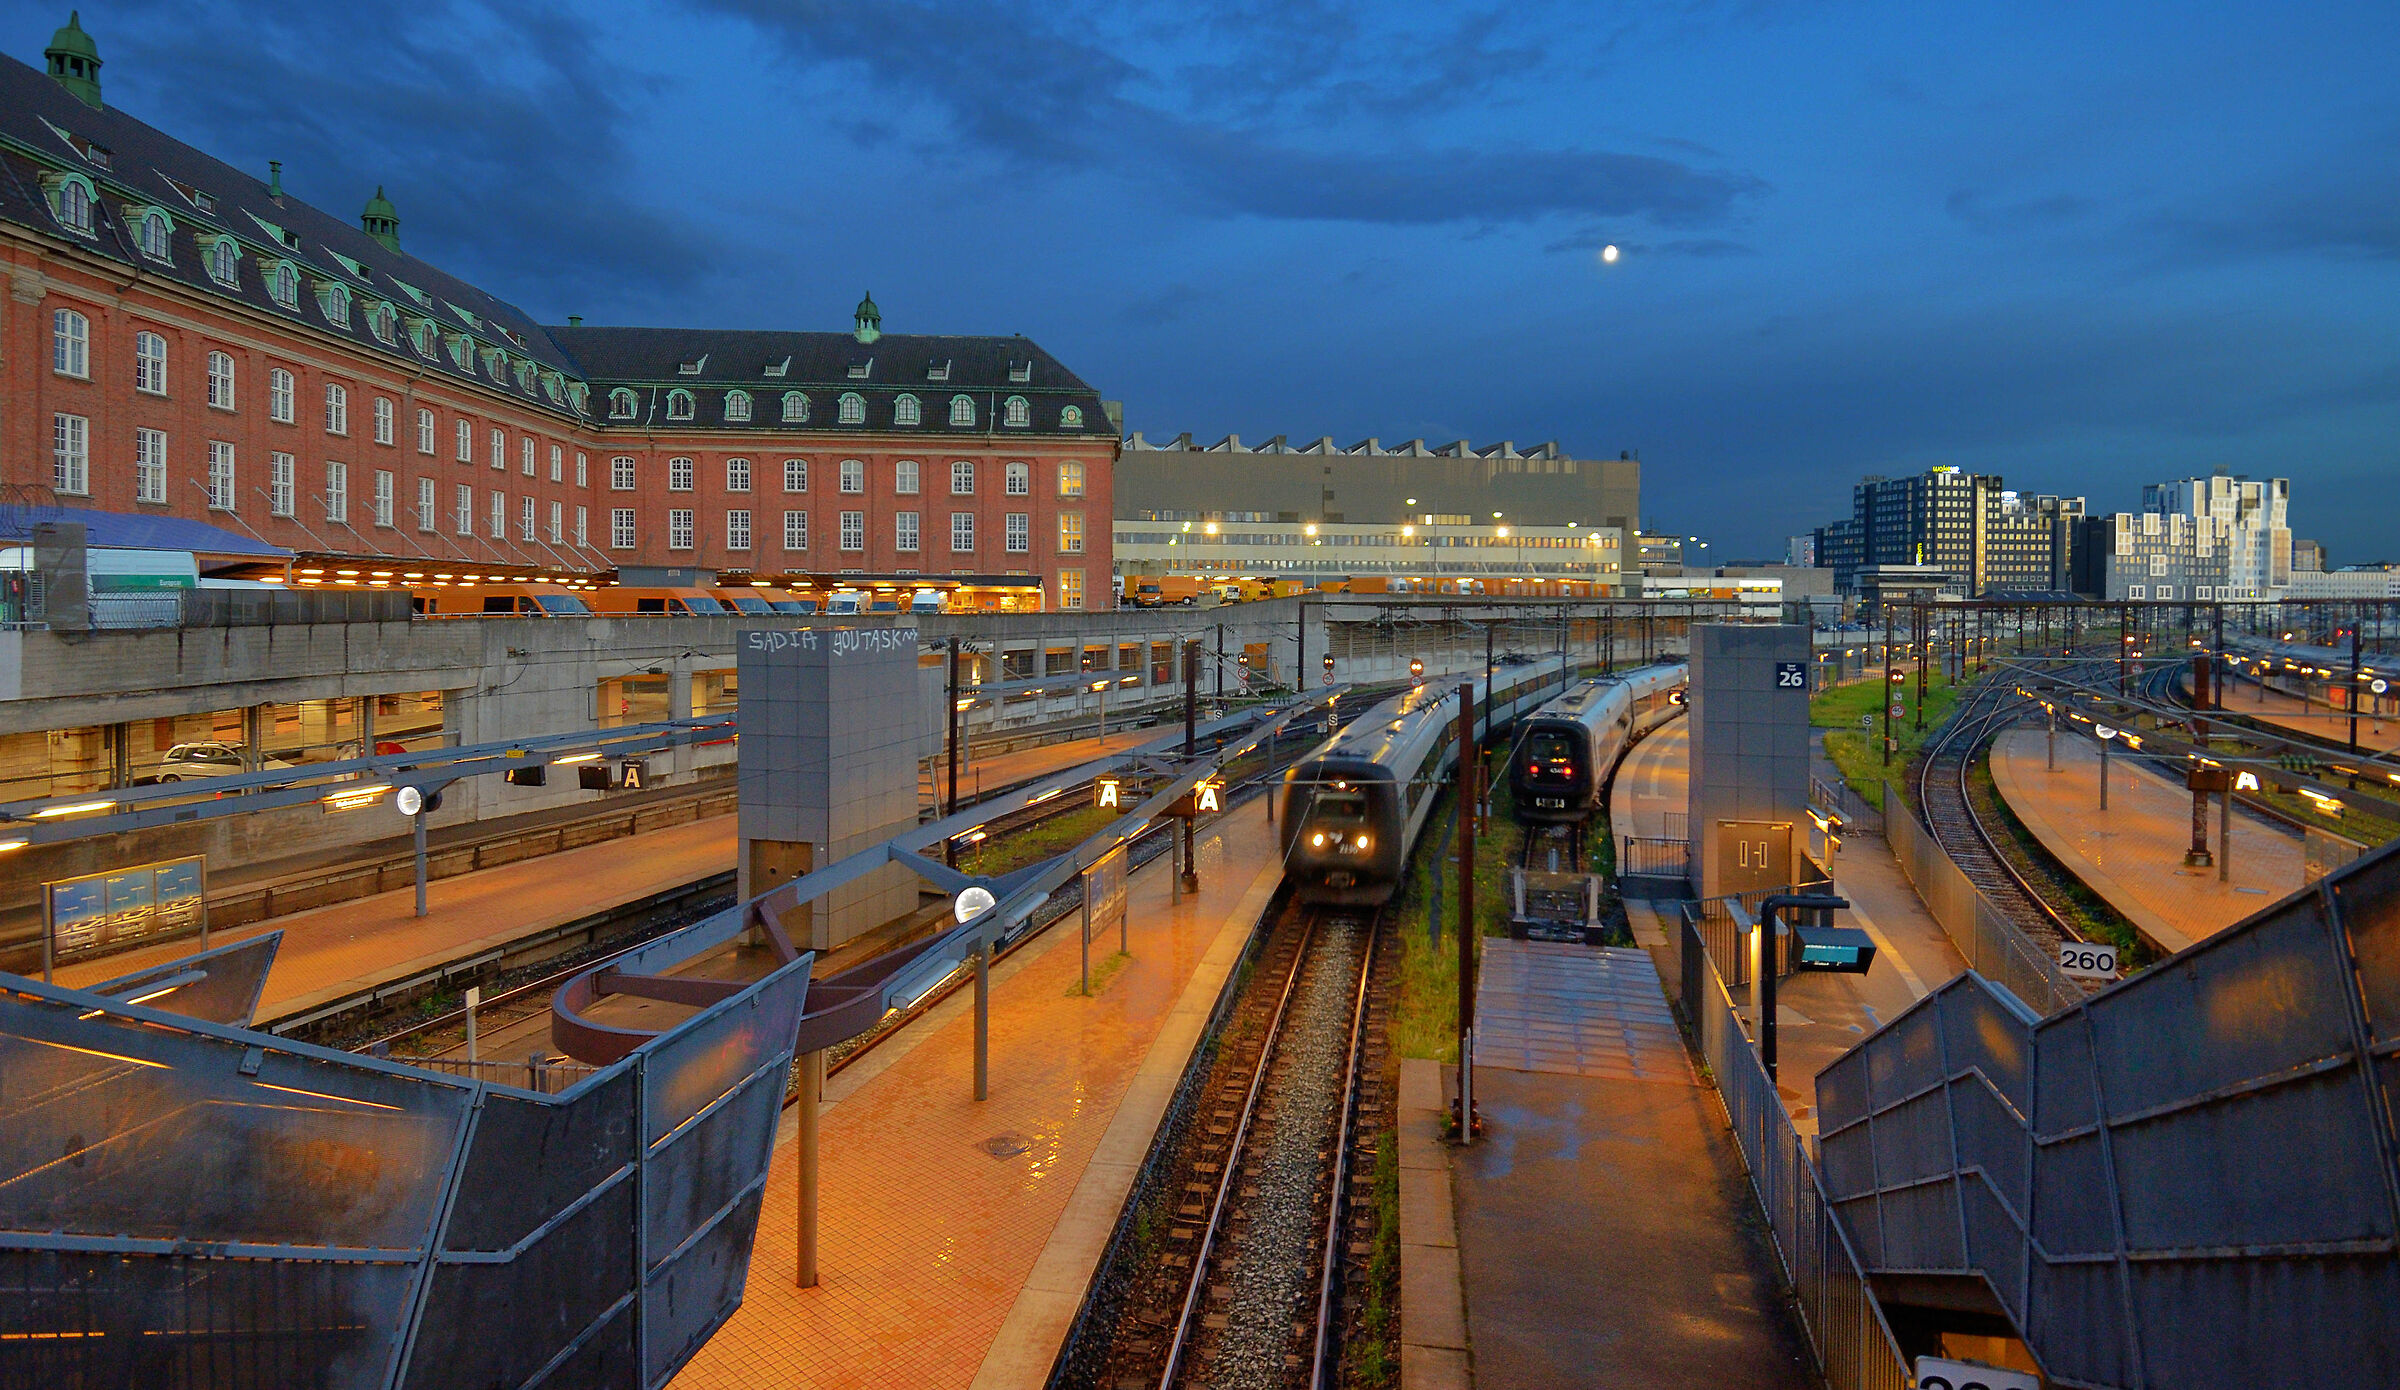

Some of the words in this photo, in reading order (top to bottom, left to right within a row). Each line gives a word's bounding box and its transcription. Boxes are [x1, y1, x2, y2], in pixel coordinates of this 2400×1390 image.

[1779, 671, 1803, 687] 26
[1669, 693, 1681, 705] C
[1216, 710, 1222, 720] S
[1330, 715, 1337, 725] S
[1863, 715, 1872, 726] S
[624, 767, 641, 788] A
[2234, 770, 2260, 791] A
[1099, 784, 1118, 807] A
[1198, 788, 1219, 811] A
[2062, 949, 2115, 972] 260
